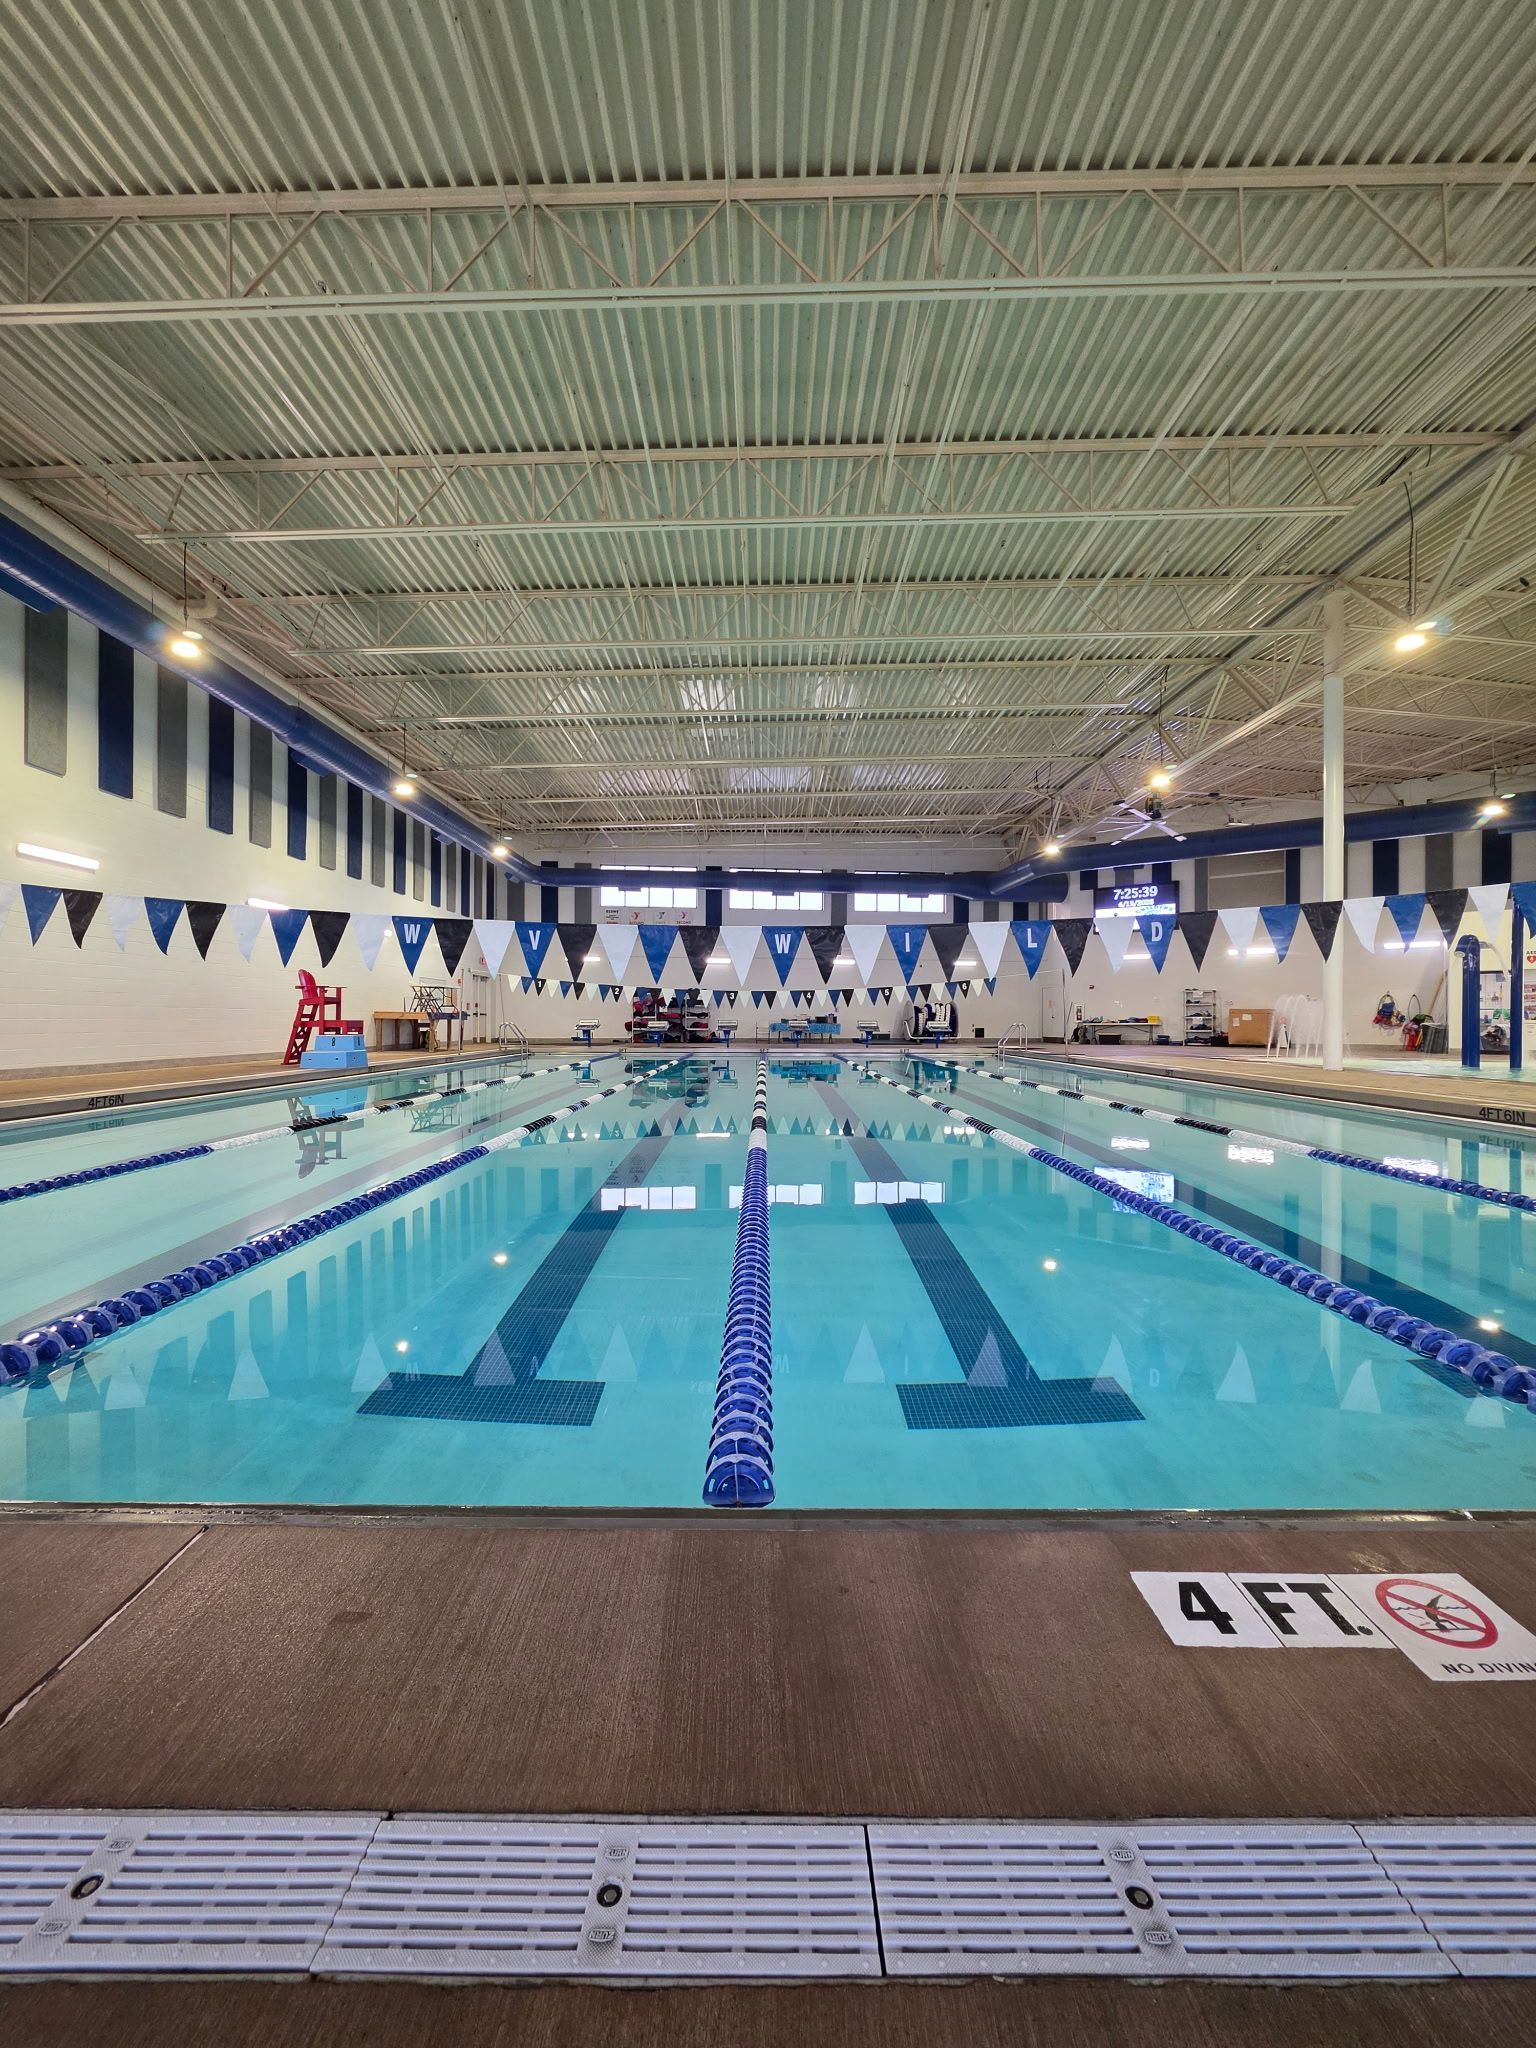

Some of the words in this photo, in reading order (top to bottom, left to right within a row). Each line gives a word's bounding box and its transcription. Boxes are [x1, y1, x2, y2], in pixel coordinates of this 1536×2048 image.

[1113, 886, 1158, 900] 7:25:39
[404, 924, 420, 944] W
[528, 930, 541, 950] V
[774, 934, 791, 954] W
[905, 932, 910, 952] I
[1027, 928, 1038, 948] L
[1151, 922, 1163, 942] D
[614, 987, 620, 995] 2
[729, 992, 735, 1000] 3
[1178, 1581, 1238, 1635] 4
[1241, 1581, 1373, 1636] FT.
[1441, 1663, 1474, 1673] NO
[1477, 1663, 1536, 1673] DIVIN
